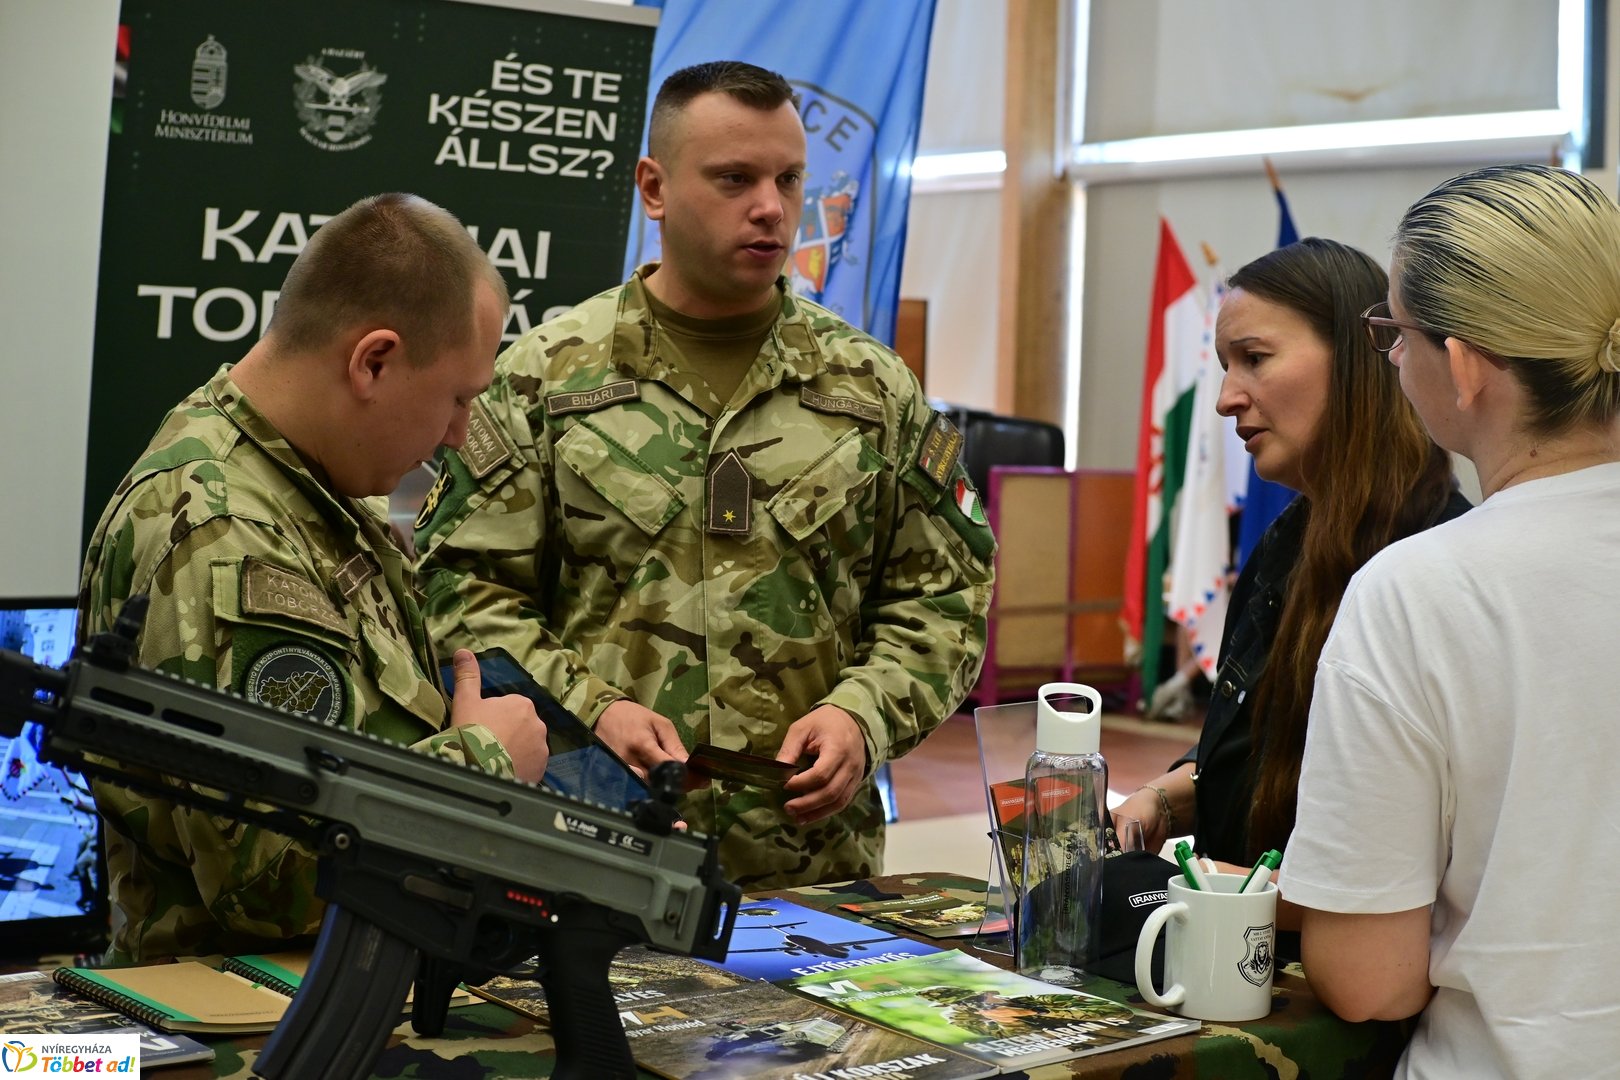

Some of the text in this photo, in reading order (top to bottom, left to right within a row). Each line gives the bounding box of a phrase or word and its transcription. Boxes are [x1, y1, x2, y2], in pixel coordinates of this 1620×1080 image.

[491, 52, 622, 104] ÉS TE
[428, 88, 618, 142] KÉSZEN
[434, 126, 615, 180] ÁLLSZ?
[571, 388, 615, 406] BIHARI
[811, 394, 867, 414] HUNGARY
[469, 417, 497, 453] ATONAI
[653, 1018, 707, 1033] Honvéd
[829, 1053, 948, 1078] KORSZAK
